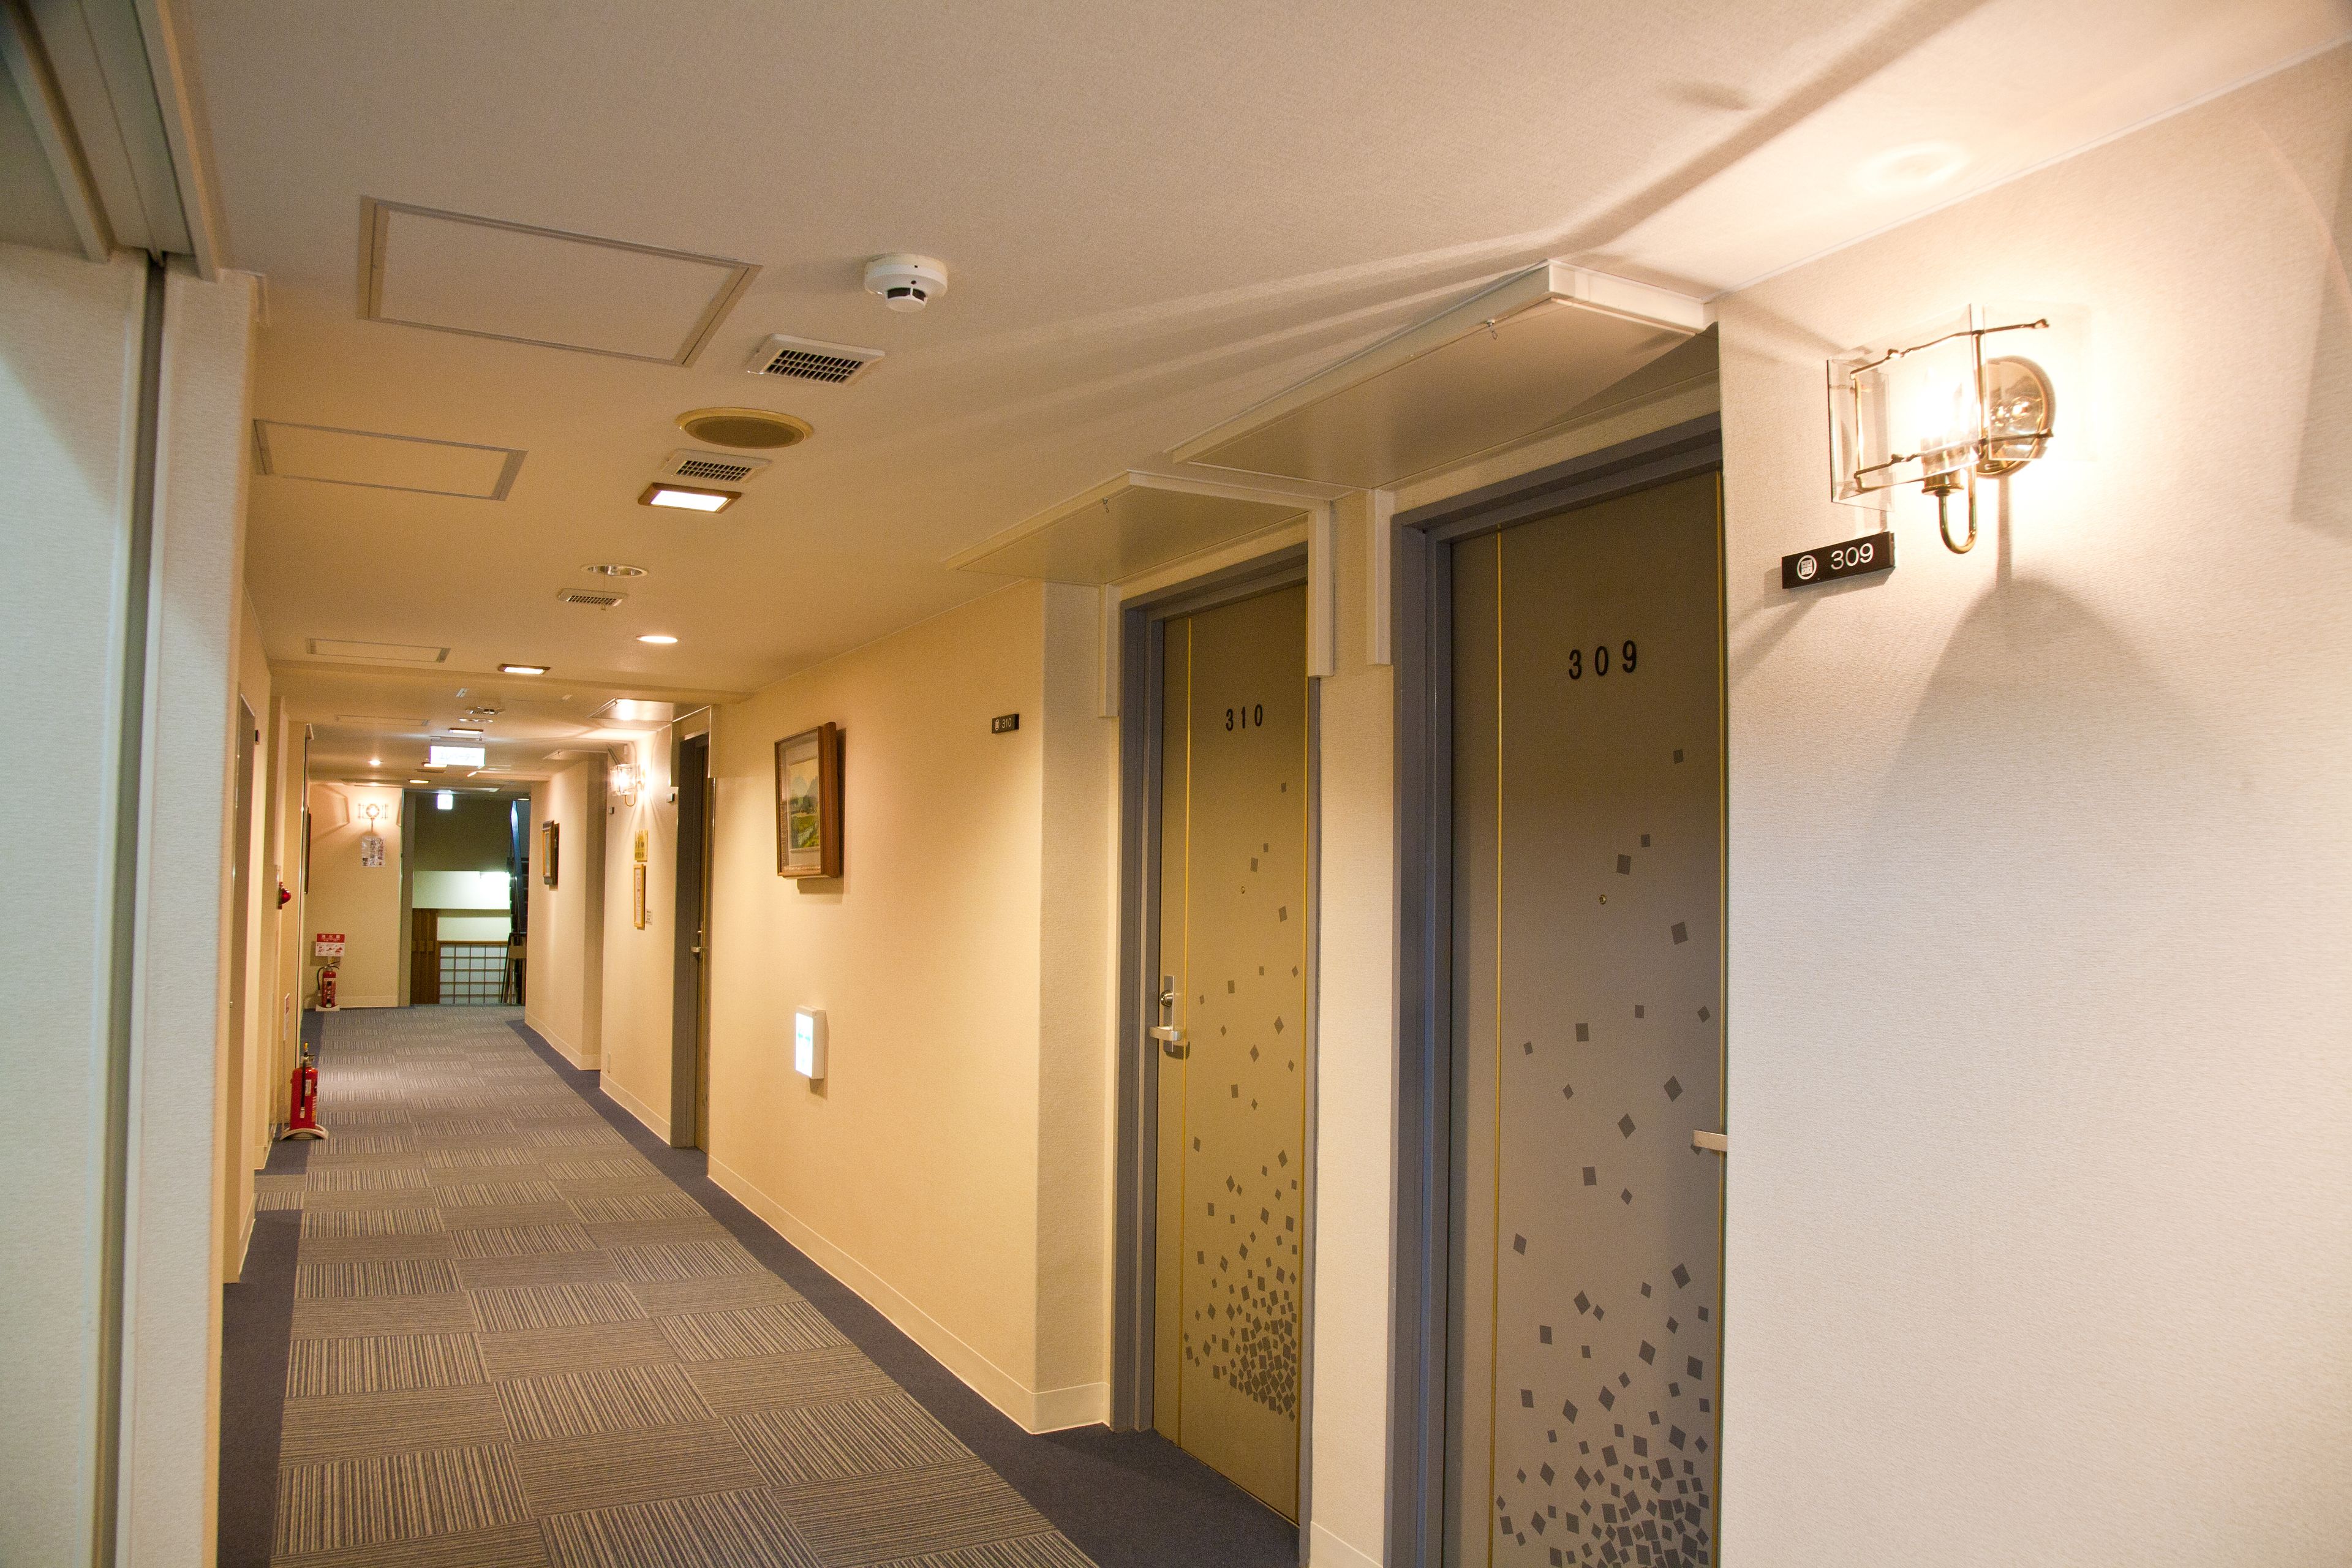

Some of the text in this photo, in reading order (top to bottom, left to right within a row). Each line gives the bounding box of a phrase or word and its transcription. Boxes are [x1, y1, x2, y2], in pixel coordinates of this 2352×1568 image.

[1831, 543, 1874, 570] 309
[1569, 640, 1637, 680] 309
[1001, 717, 1012, 728] 310
[1226, 704, 1262, 731] 310
